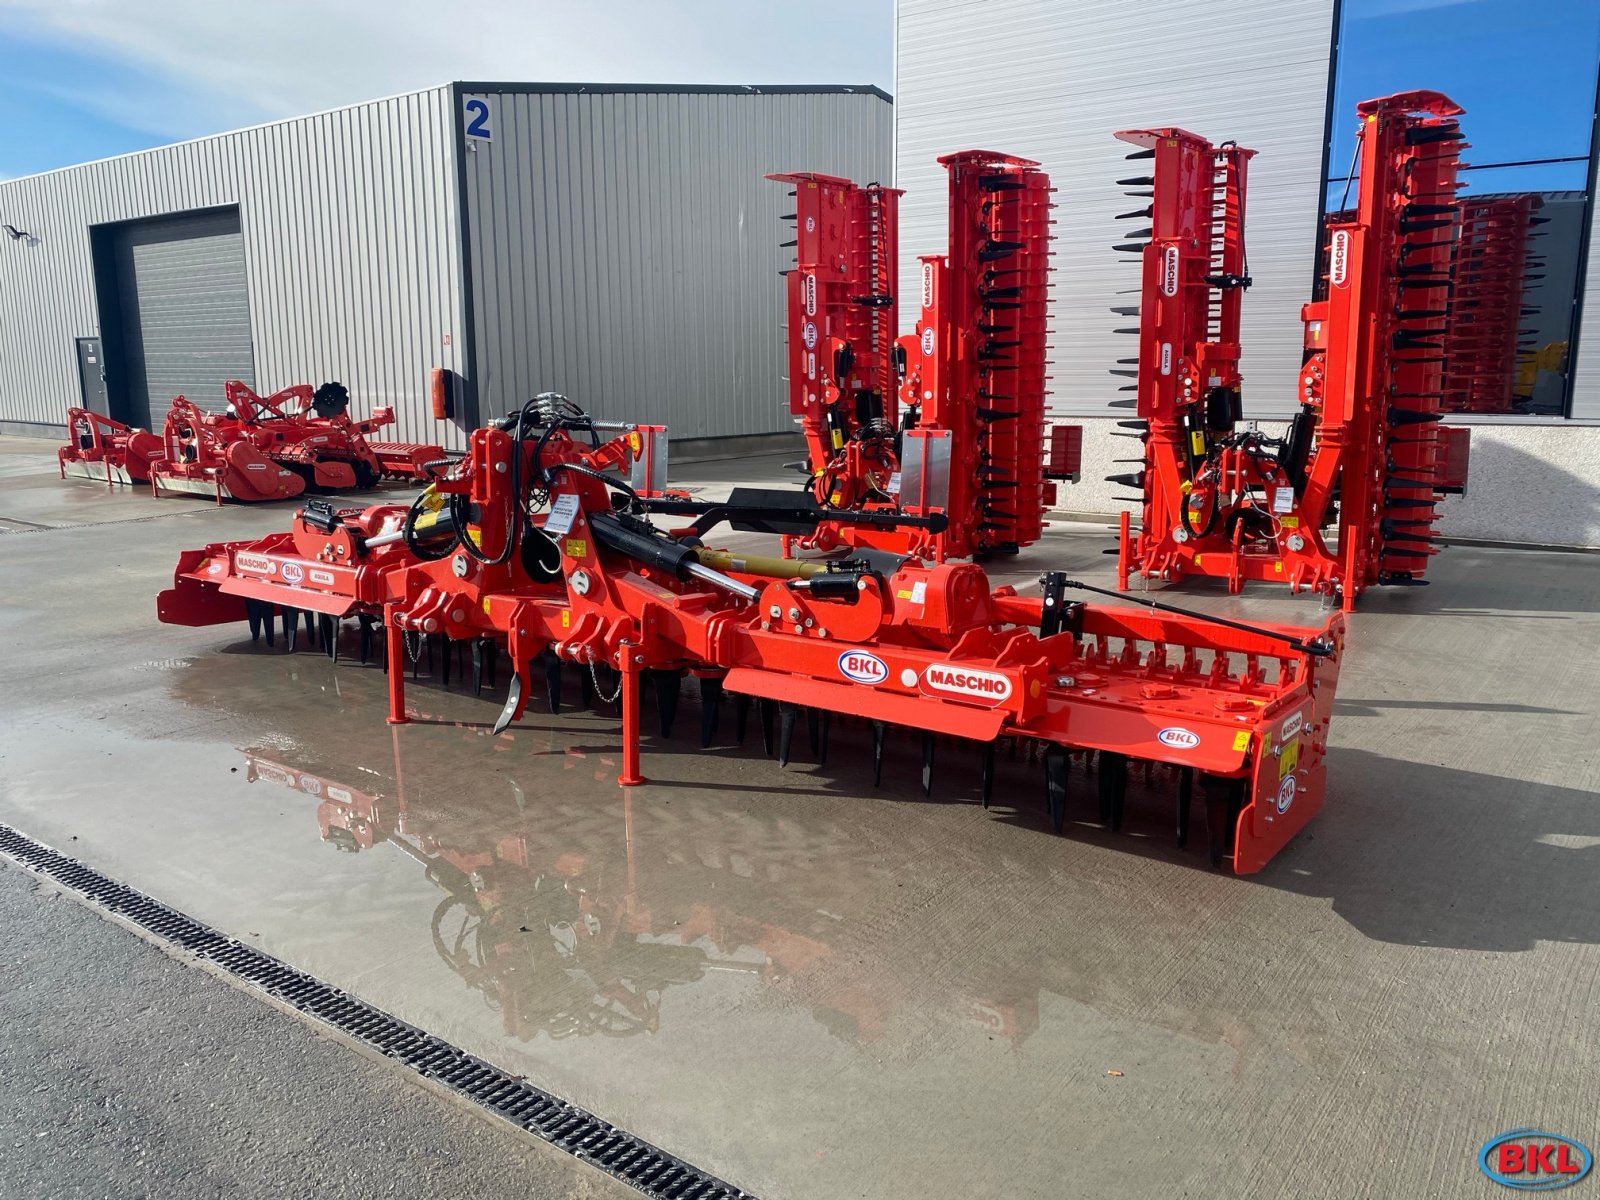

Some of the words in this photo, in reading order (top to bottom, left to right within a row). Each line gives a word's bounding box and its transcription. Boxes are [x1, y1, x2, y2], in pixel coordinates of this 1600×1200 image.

[466, 99, 491, 138] 2
[1335, 233, 1345, 281] MASCHIO
[1167, 249, 1176, 293] MASCHIO
[238, 557, 268, 570] MASCHIO
[285, 565, 301, 577] BKL
[847, 657, 882, 676] BKL
[930, 670, 1006, 694] MASCHIO
[1165, 731, 1194, 744] BKL
[1282, 716, 1301, 737] MASCHIO
[1281, 780, 1294, 805] BKL
